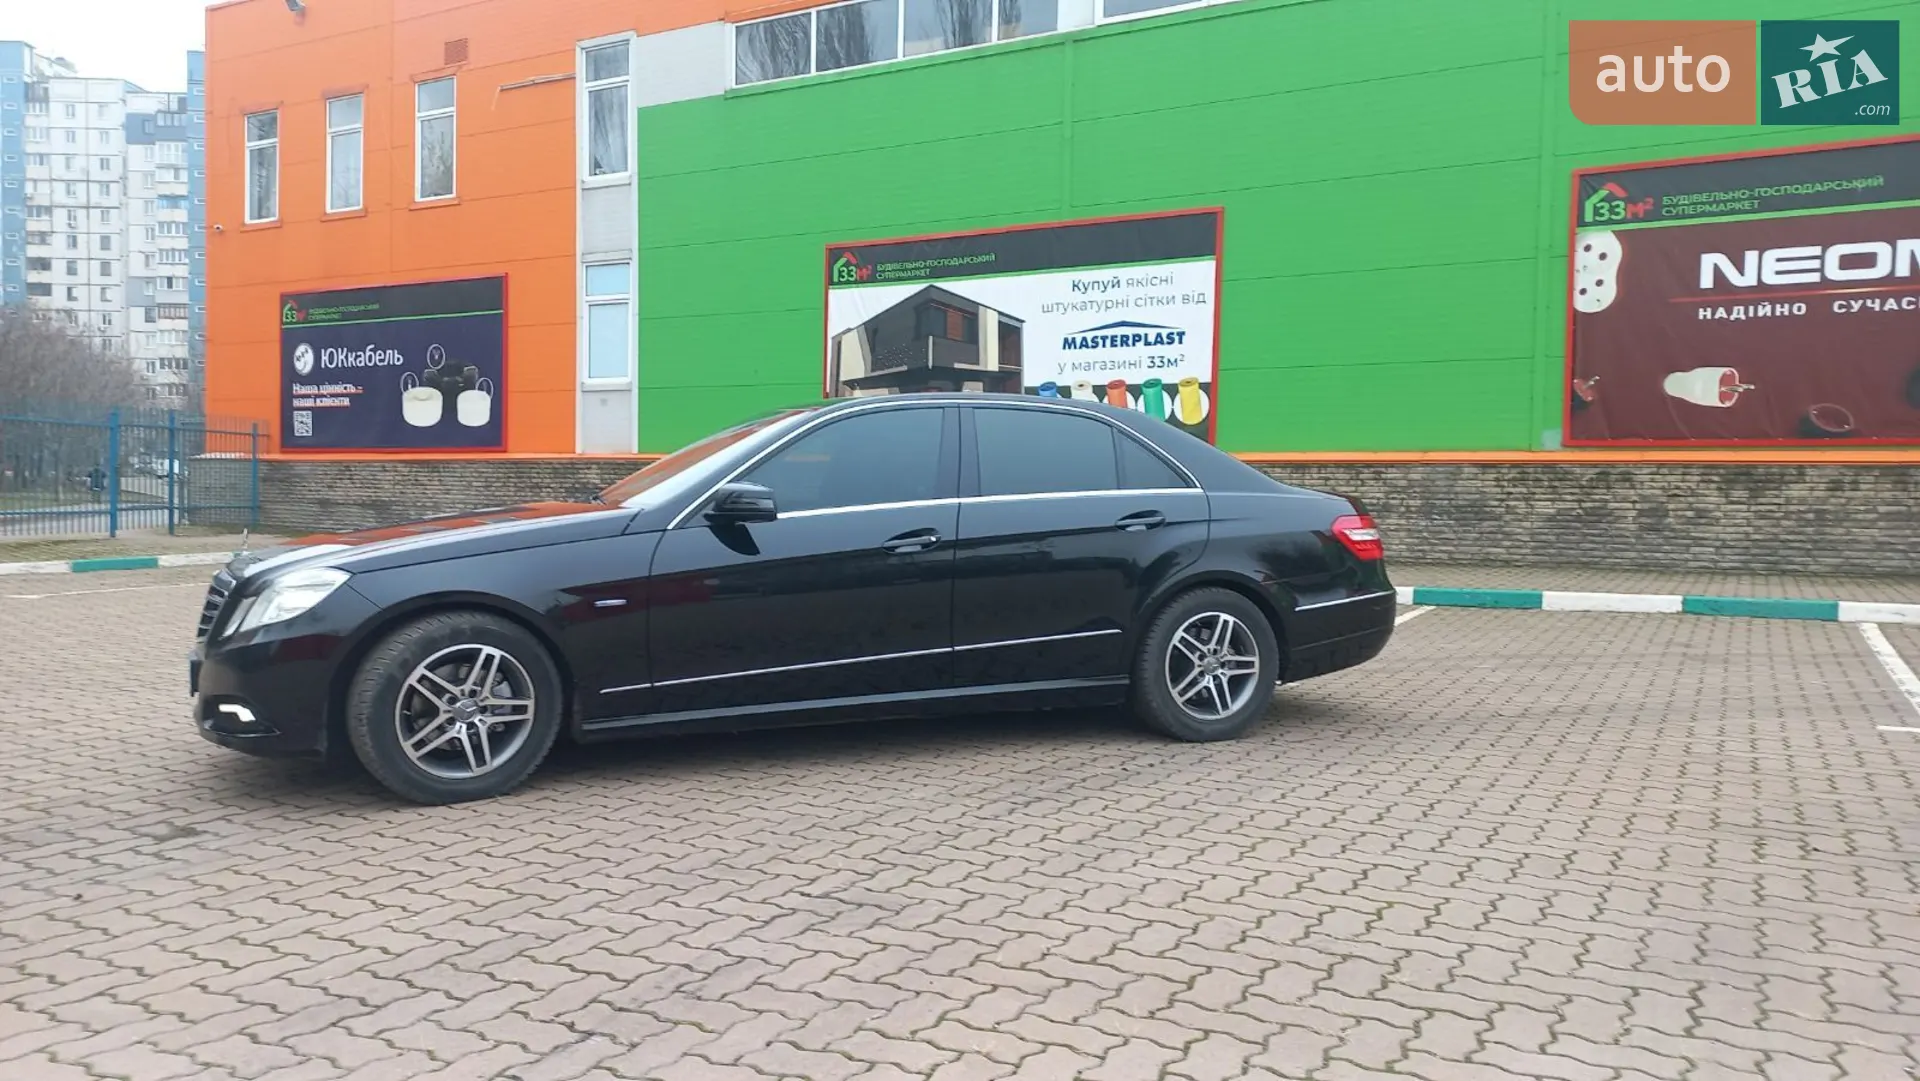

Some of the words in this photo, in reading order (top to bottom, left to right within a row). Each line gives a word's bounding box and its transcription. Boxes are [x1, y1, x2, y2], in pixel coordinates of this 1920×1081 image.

[1662, 175, 1885, 206] БУДІВЕЛЬНО-ГОСПОДАРСЬКИЙ
[1662, 199, 1761, 217] СУПЕРМАРКЕТ
[1072, 276, 1121, 294] Купуй
[1126, 271, 1174, 288] якісні
[1041, 296, 1130, 315] штукатурні
[1134, 293, 1176, 308] сітки
[1181, 290, 1207, 305] від
[1698, 302, 1808, 321] НАДІЙНО
[1832, 296, 1920, 314] СУЧАС
[1062, 331, 1186, 350] MASTERPLAST
[321, 344, 404, 369] ЮКкабель
[1058, 362, 1067, 375] у
[1071, 356, 1142, 372] магазині
